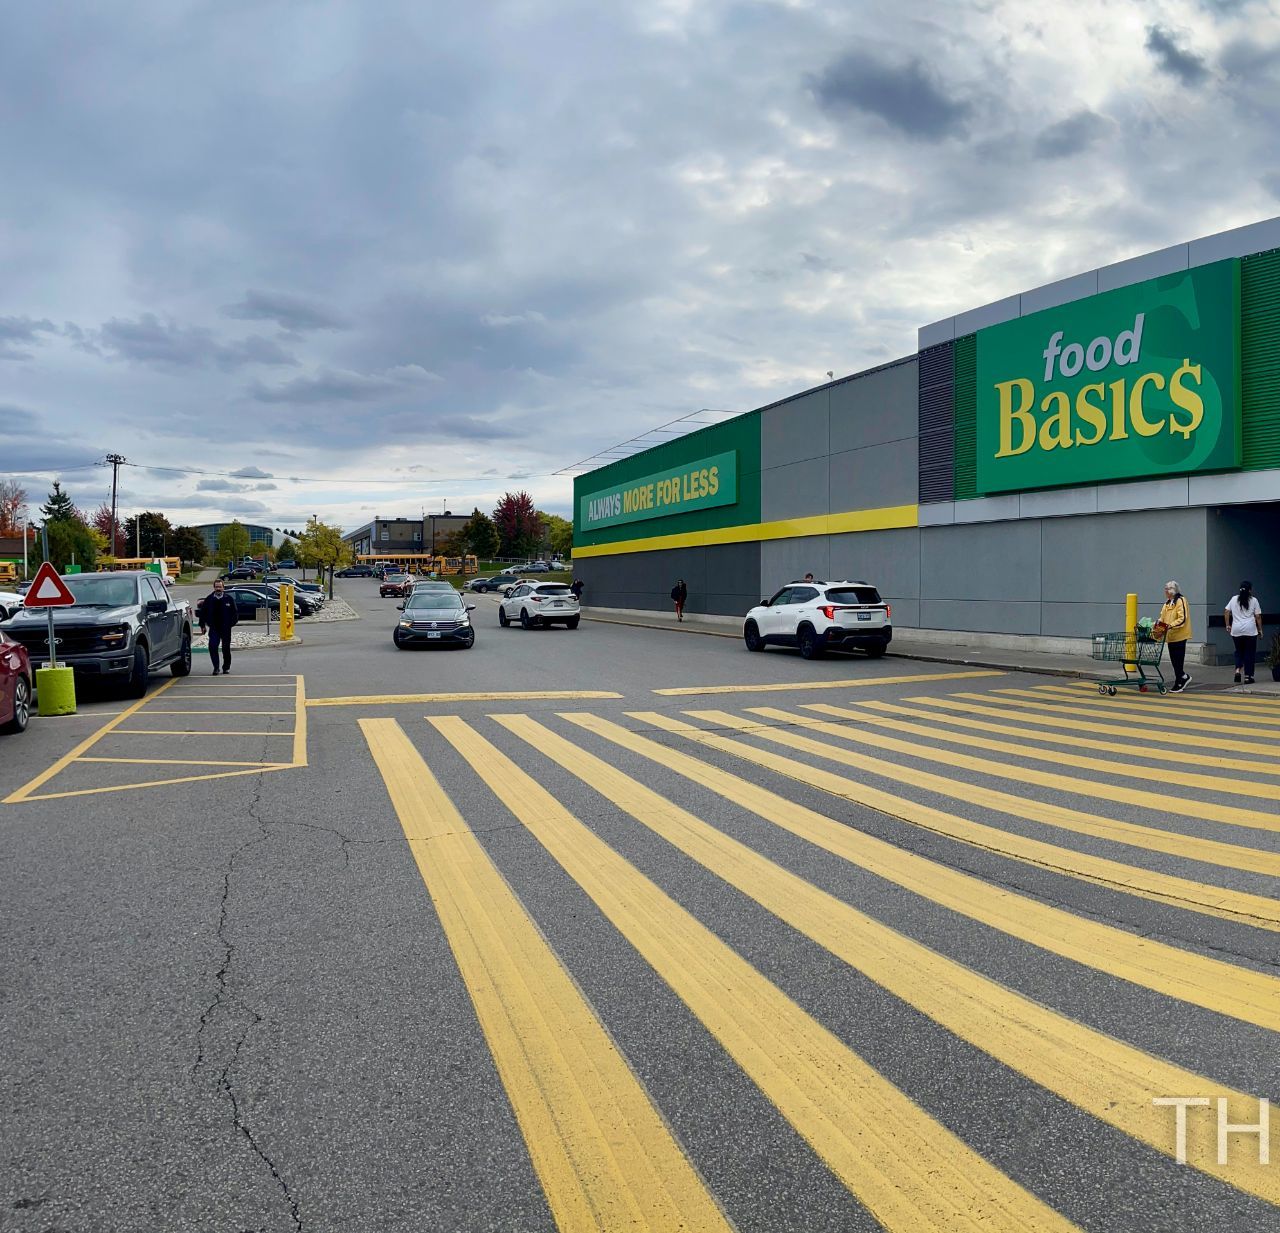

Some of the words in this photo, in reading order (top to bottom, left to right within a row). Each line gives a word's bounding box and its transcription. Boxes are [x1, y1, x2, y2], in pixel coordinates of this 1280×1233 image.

[1043, 313, 1145, 381] food
[588, 493, 621, 522] ALWAYS
[623, 483, 654, 514] MORE
[656, 477, 681, 507] FOR
[683, 466, 719, 501] LESS
